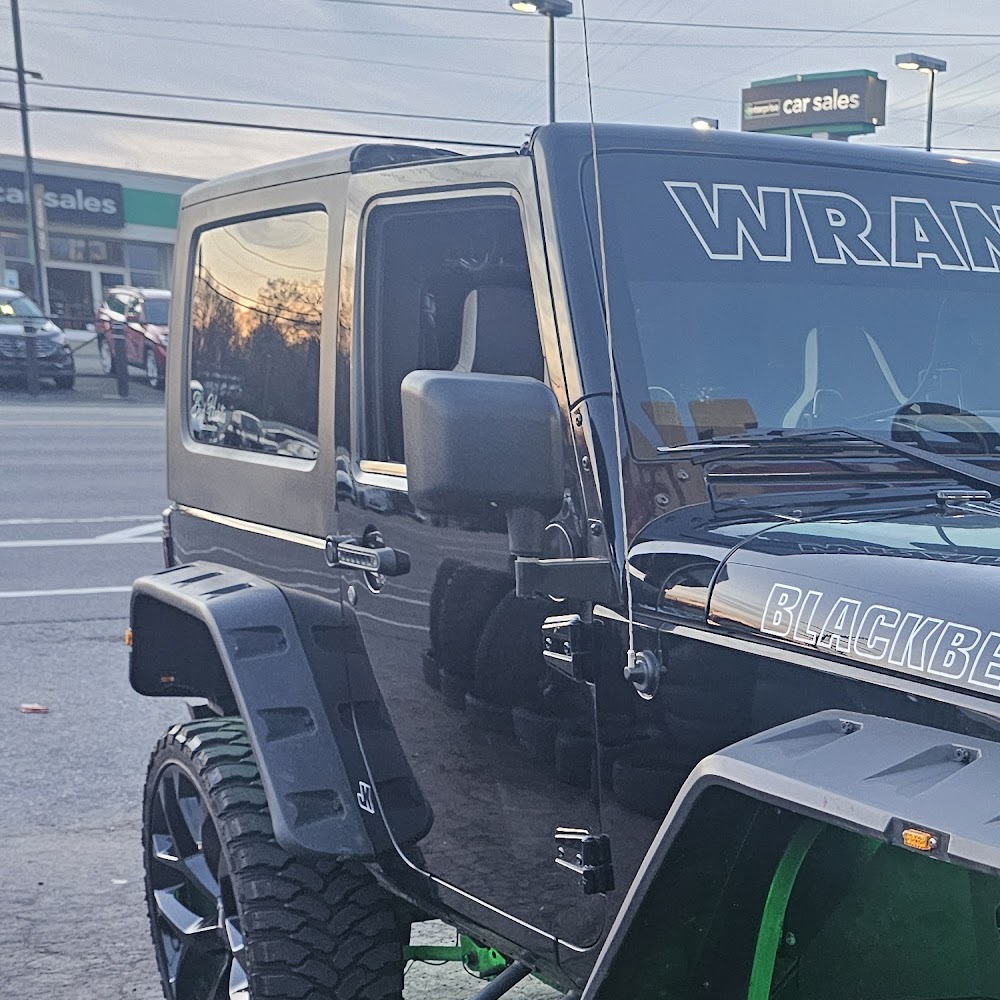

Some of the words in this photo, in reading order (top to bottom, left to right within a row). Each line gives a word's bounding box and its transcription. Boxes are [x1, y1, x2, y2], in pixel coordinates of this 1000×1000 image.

[783, 98, 811, 115] car
[812, 88, 860, 112] sales
[44, 188, 118, 215] sales
